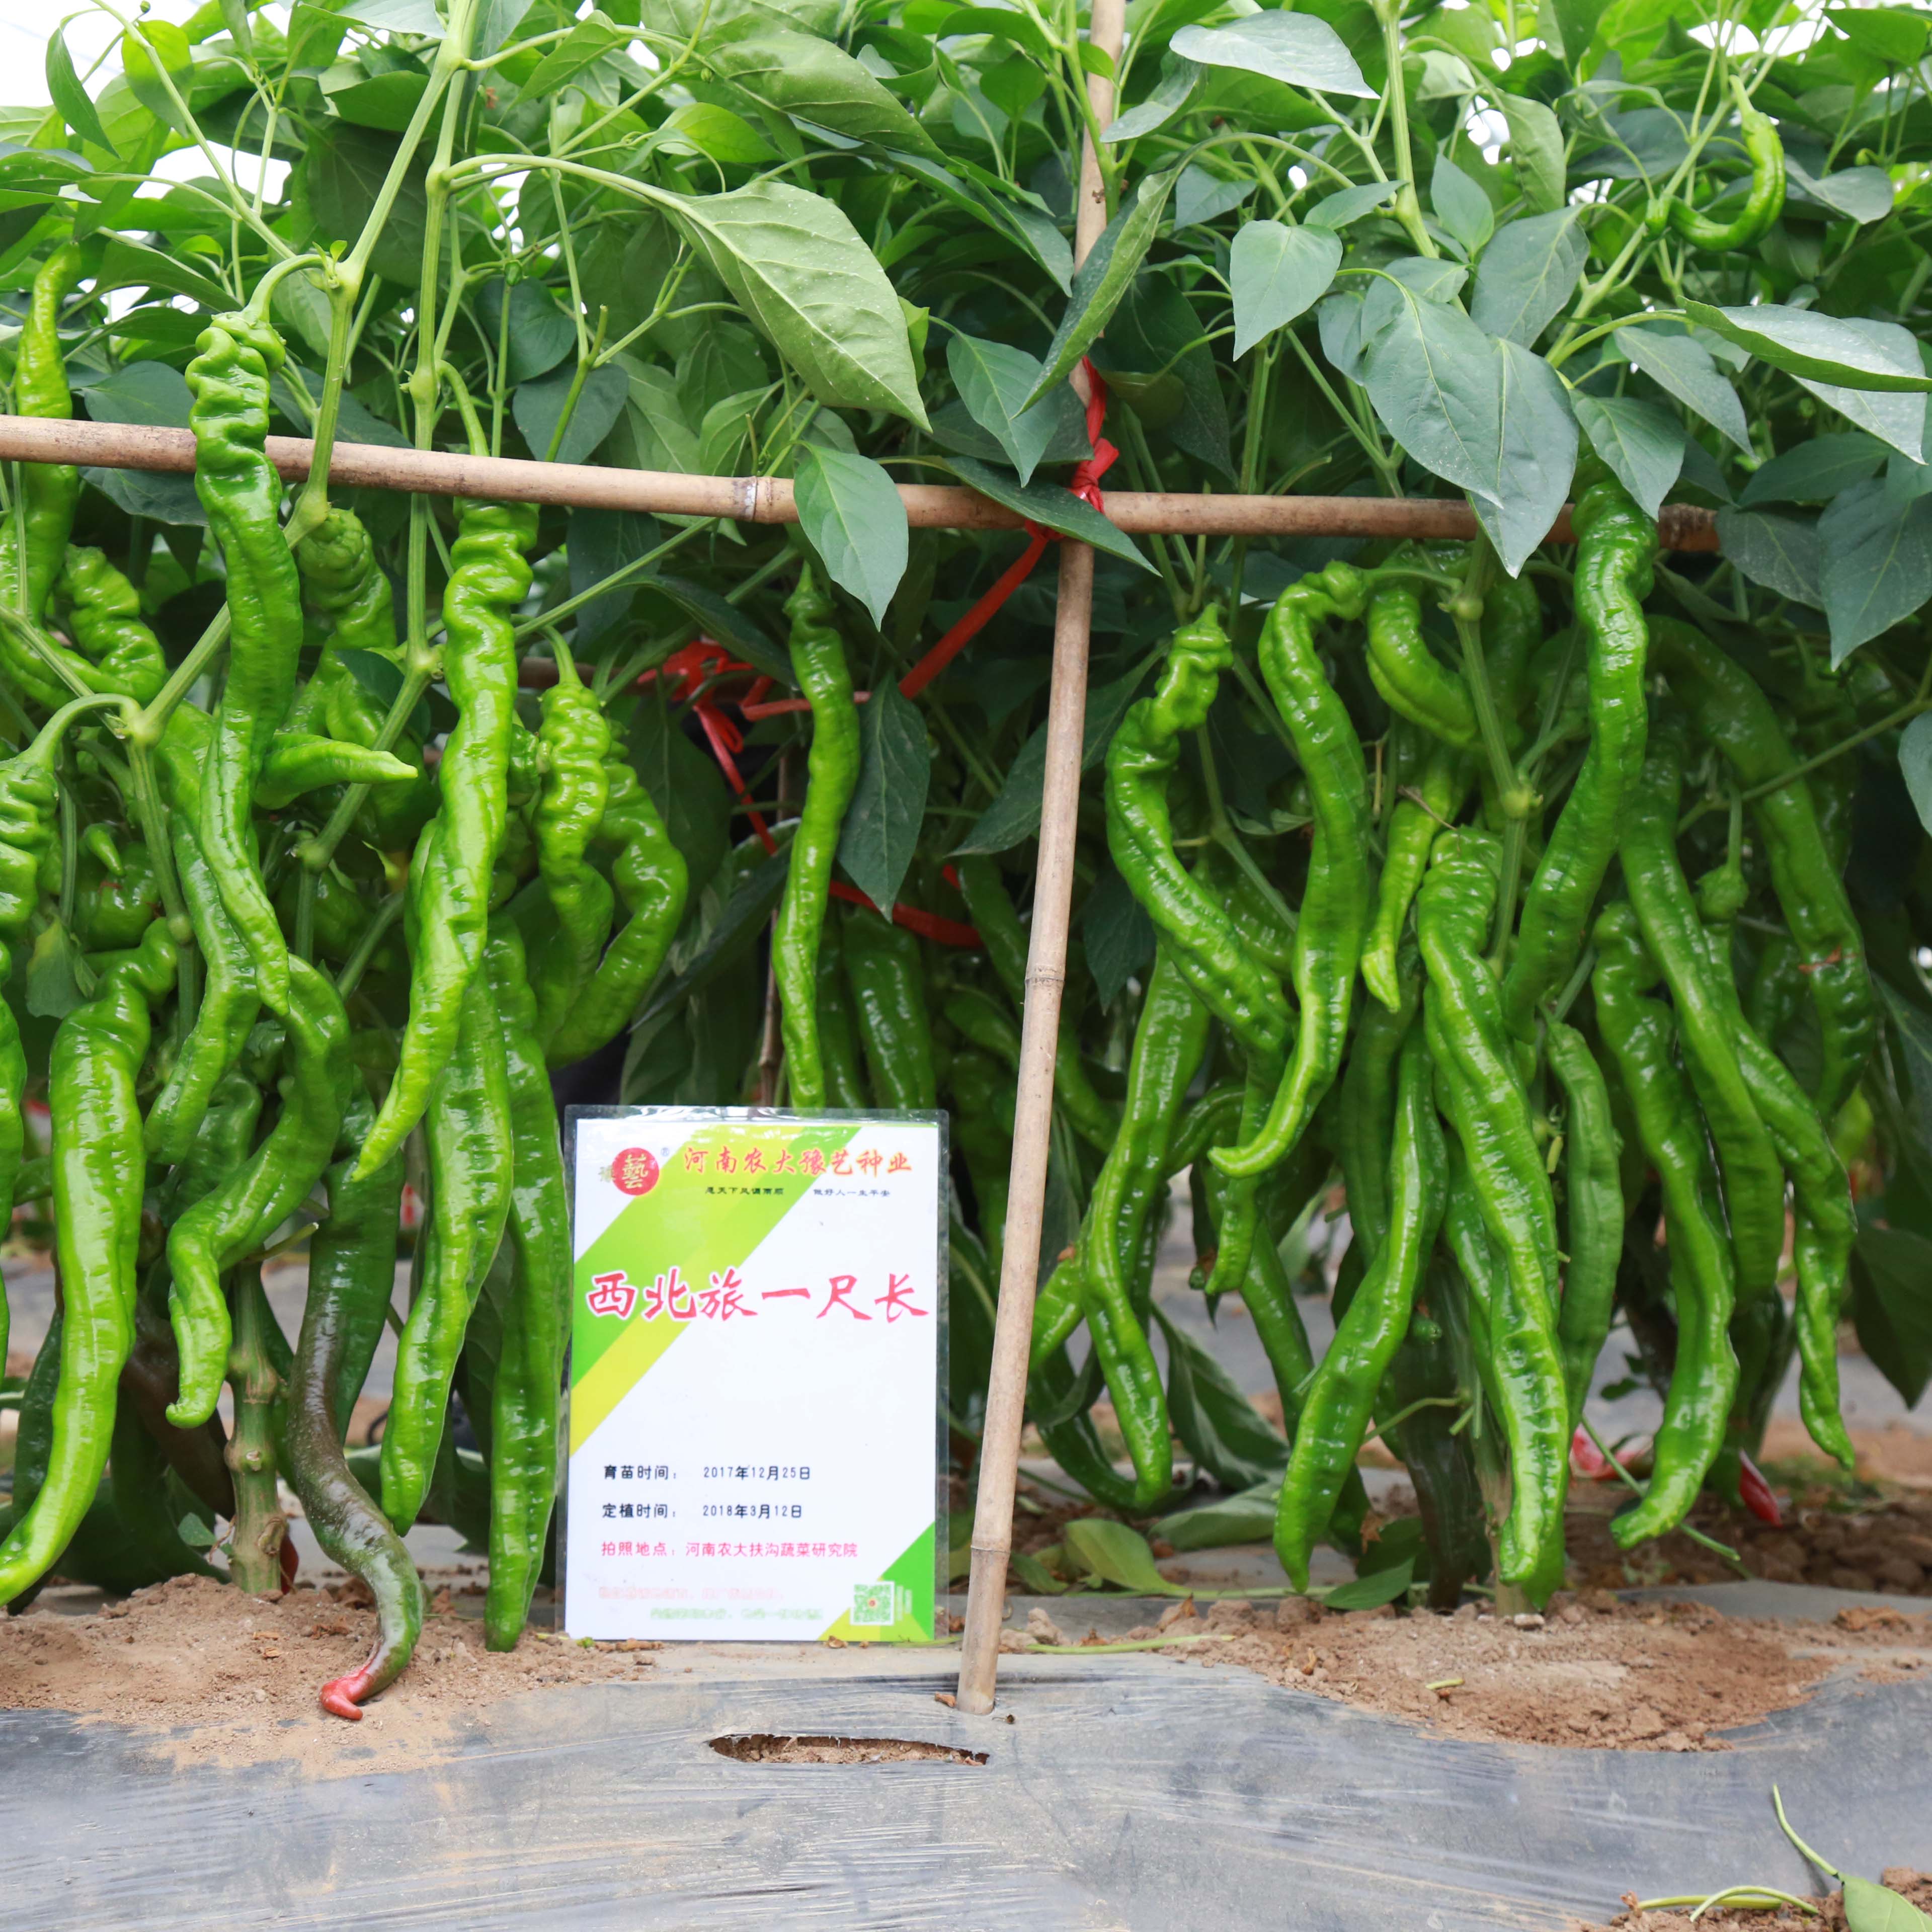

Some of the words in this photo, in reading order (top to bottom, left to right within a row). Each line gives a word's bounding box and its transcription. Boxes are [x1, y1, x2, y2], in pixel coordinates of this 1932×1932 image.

[684, 1146, 912, 1176] 河南农大豫艺种业
[587, 1267, 930, 1323] 西北旅一尺长
[604, 1465, 678, 1480] 育苗时间：
[703, 1465, 811, 1481] 2017年12月25日
[602, 1503, 677, 1518] 定植时间：
[702, 1503, 802, 1518] 2018年3月12日
